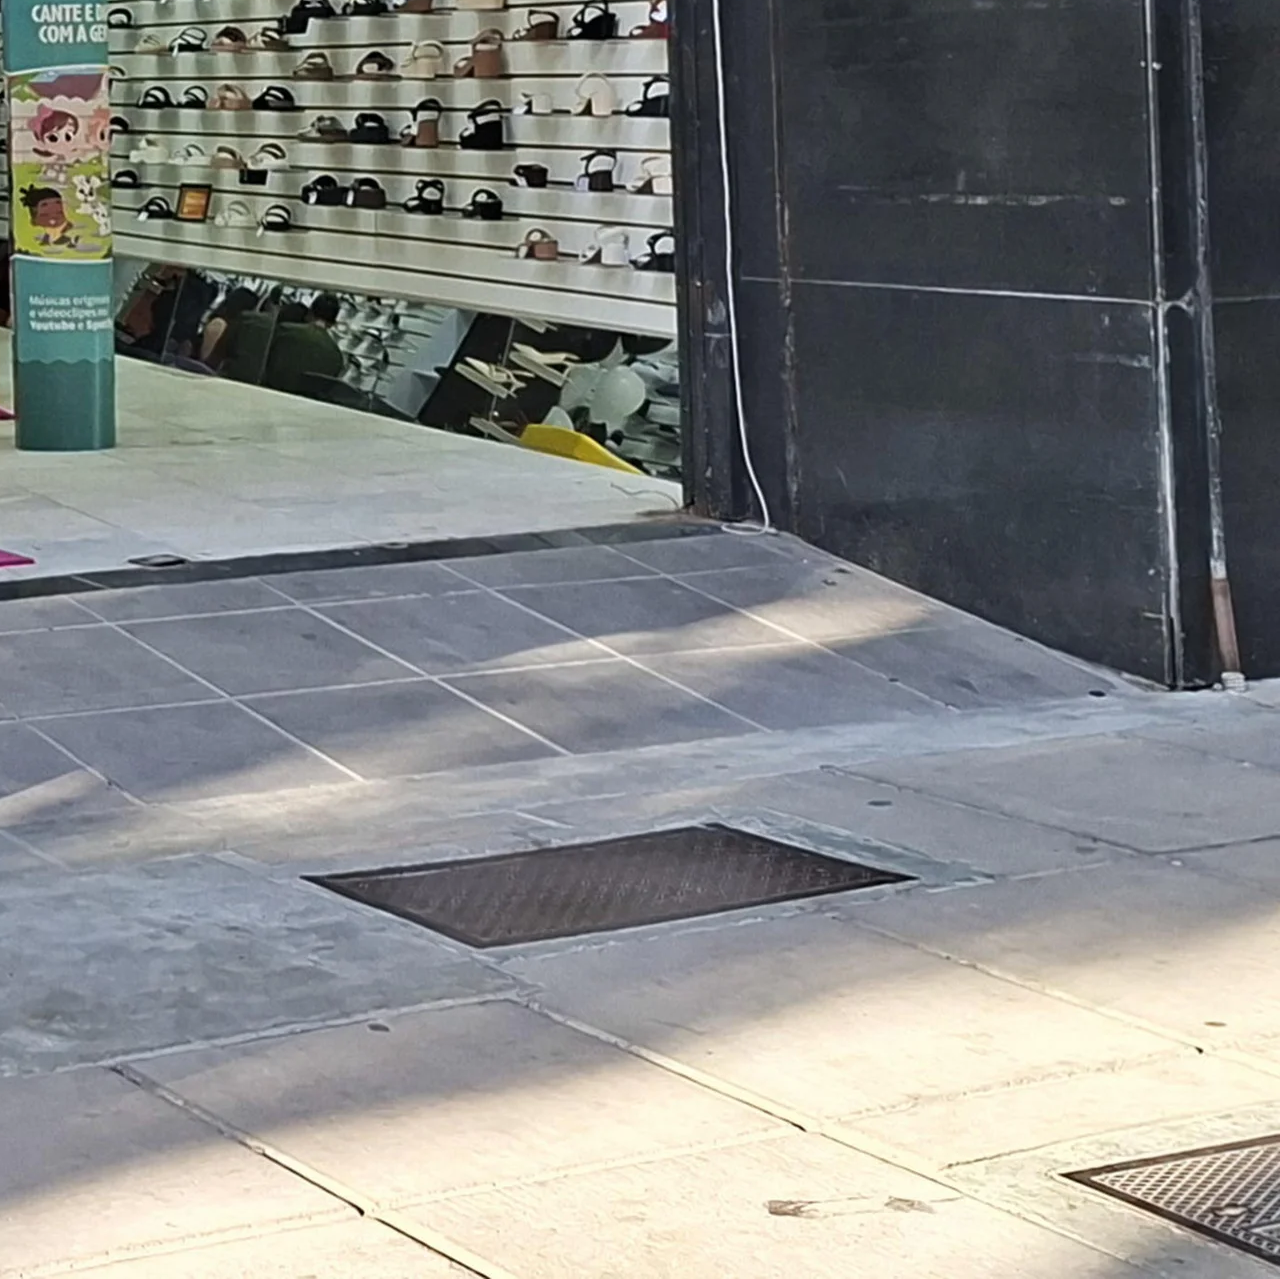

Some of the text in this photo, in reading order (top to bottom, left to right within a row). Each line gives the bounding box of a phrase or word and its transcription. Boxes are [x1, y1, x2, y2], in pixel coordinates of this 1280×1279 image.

[31, 4, 82, 22] CANTE
[85, 4, 95, 22] E
[38, 24, 108, 43] COM A GE
